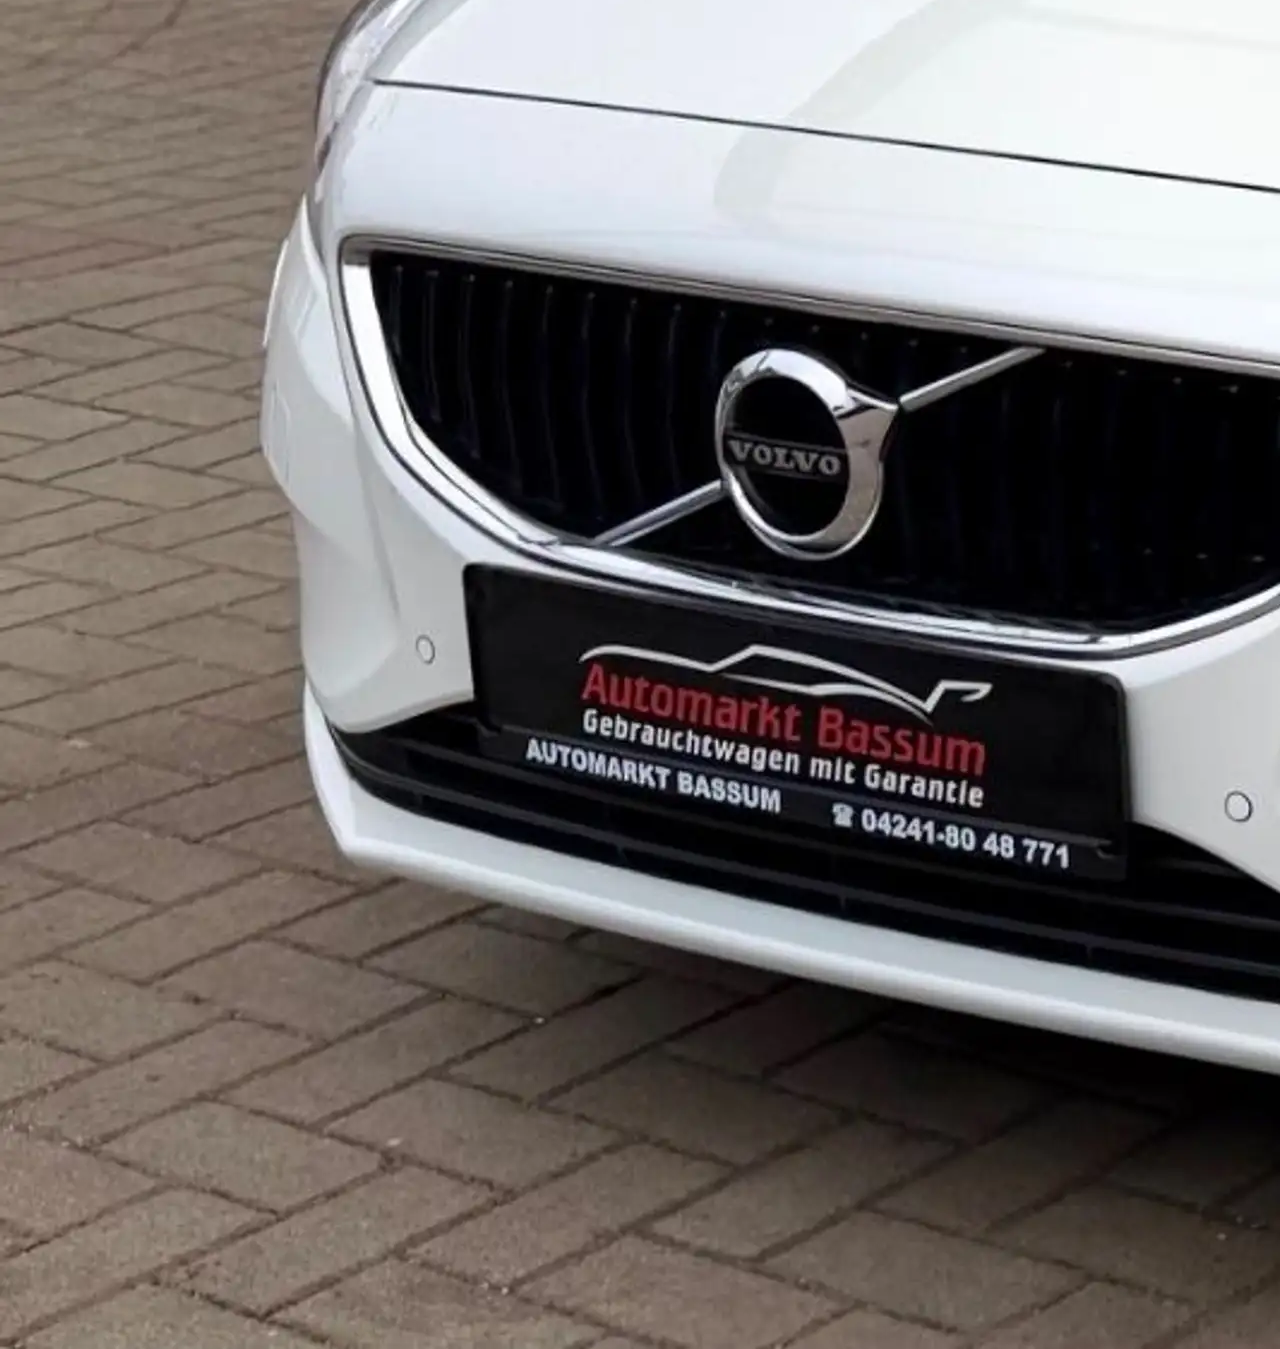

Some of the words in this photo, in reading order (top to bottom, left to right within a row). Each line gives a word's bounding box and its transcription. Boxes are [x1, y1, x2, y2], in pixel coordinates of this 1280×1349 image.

[728, 440, 841, 475] VOLVO
[581, 663, 801, 742] Automarkt
[818, 705, 986, 776] Bassum
[583, 708, 800, 775] Gebrauchtwagen
[809, 756, 855, 784] mit
[864, 763, 984, 808] Garantie
[525, 738, 672, 791] AUTOMARKT
[676, 771, 781, 814] BASSUM
[861, 808, 976, 852] 04241-80
[982, 833, 1015, 859] 48
[1022, 838, 1070, 869] 771
